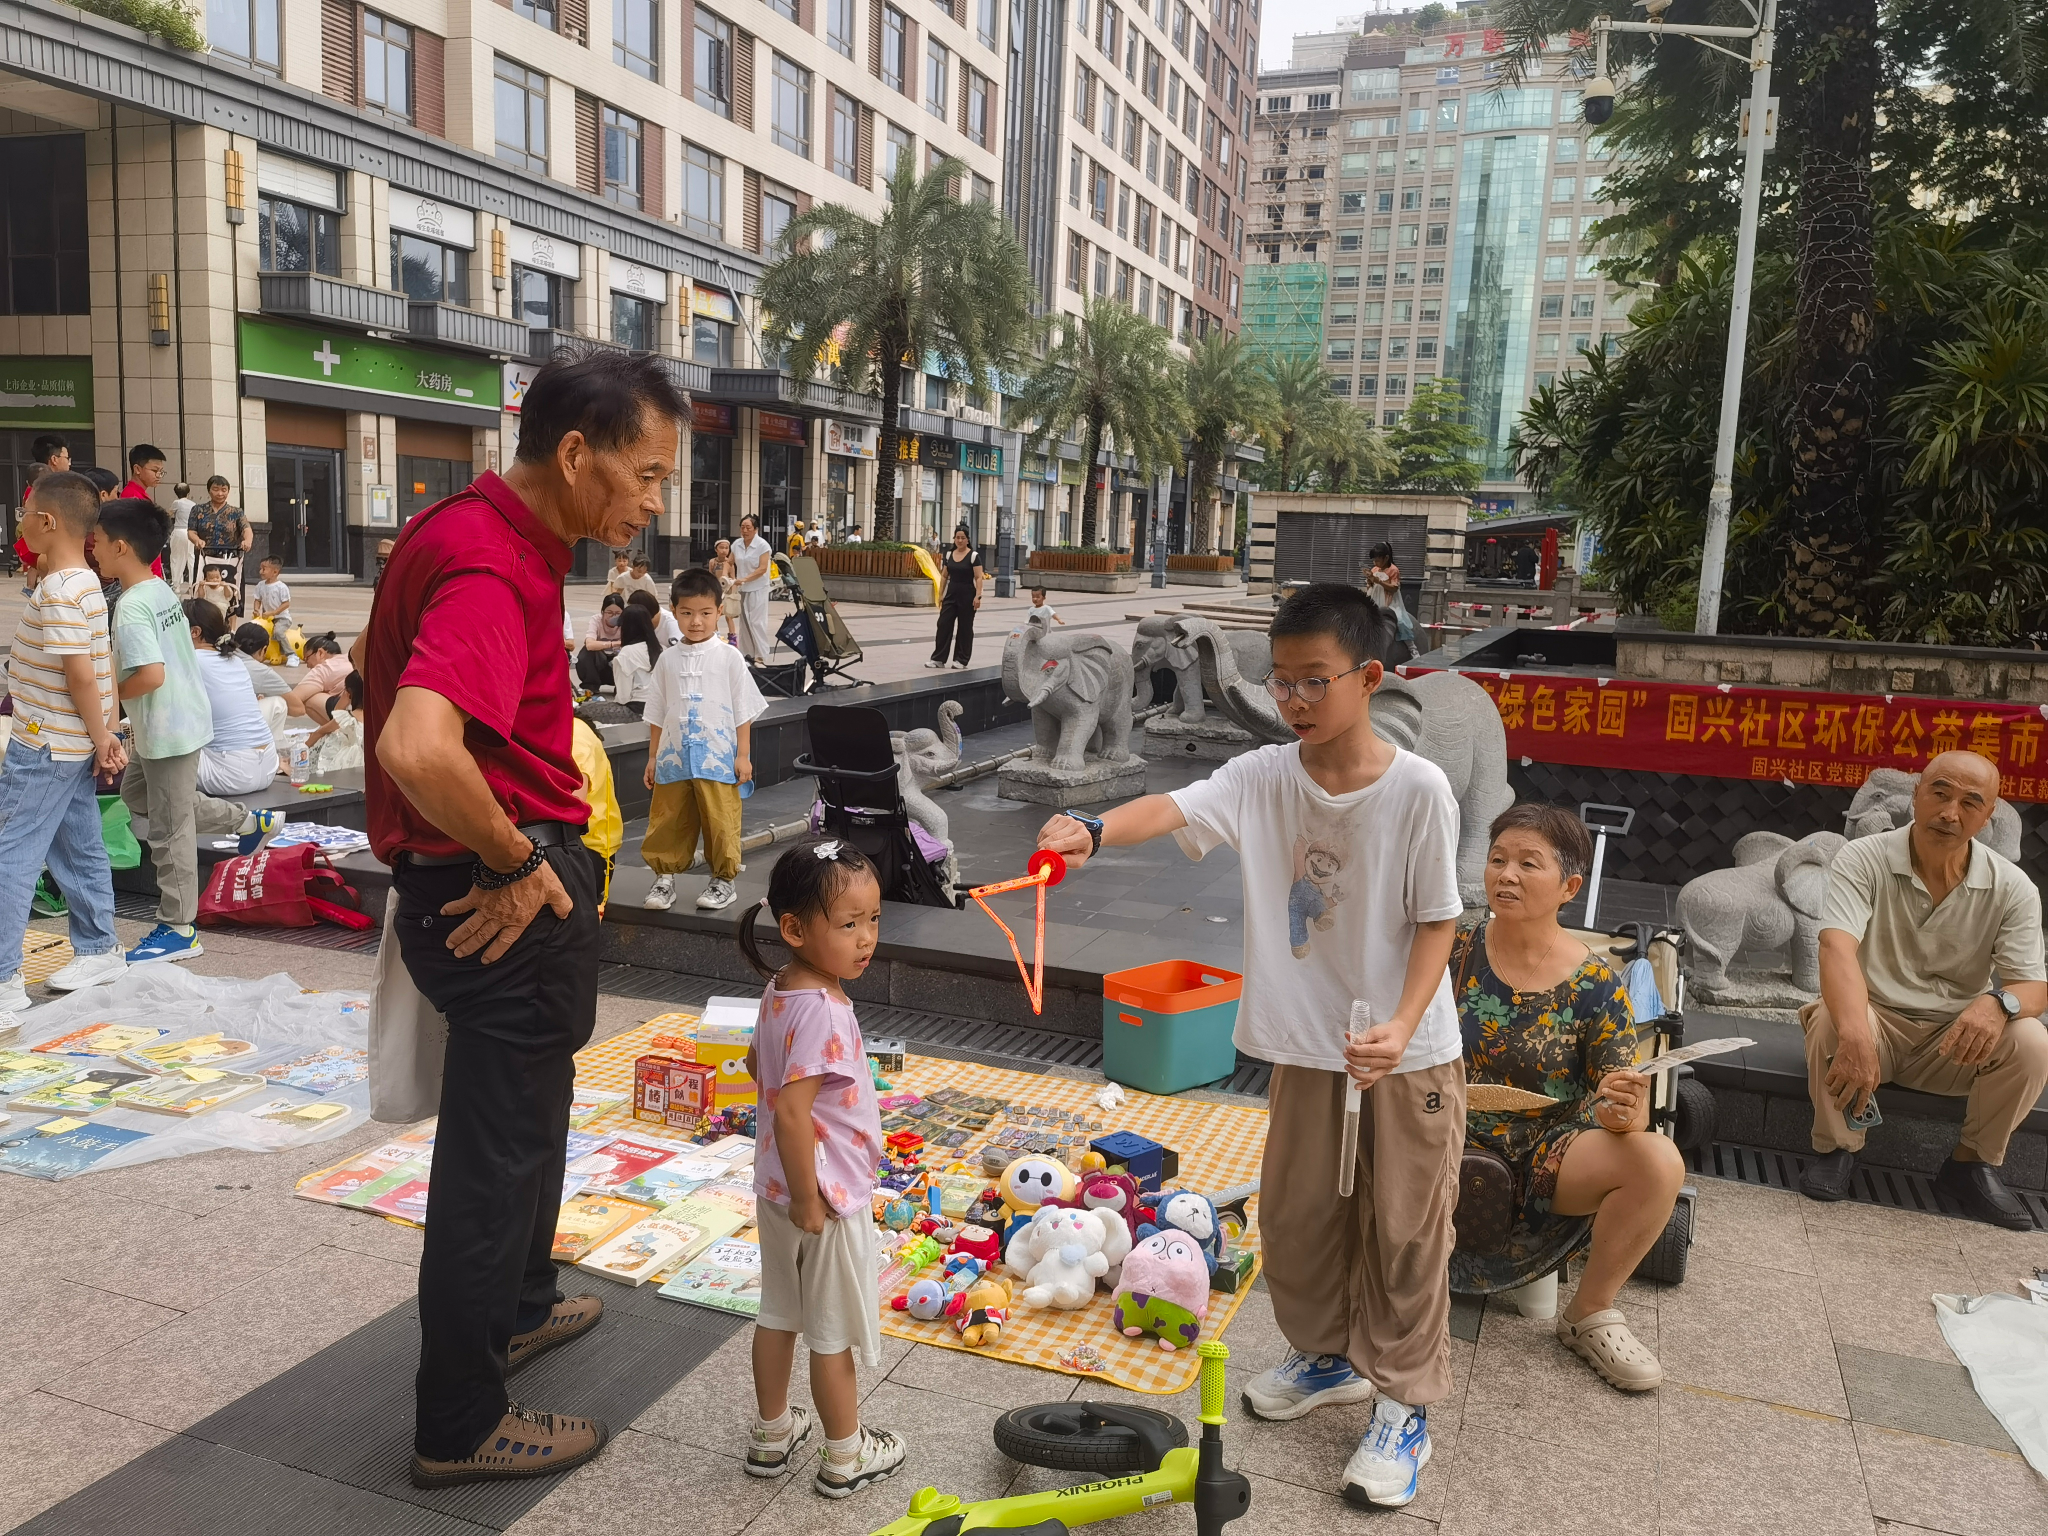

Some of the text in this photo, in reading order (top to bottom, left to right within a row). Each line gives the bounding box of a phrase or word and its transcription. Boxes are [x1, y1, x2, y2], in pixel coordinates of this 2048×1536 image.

[6, 379, 75, 392] 上市企业·品质信赖
[416, 370, 453, 393] 大药房
[966, 449, 998, 472] 河山口腔
[1666, 693, 2045, 768] 固兴社区环保公益集市
[1425, 1091, 1441, 1110] a
[1056, 1476, 1144, 1498] PHOENIX
